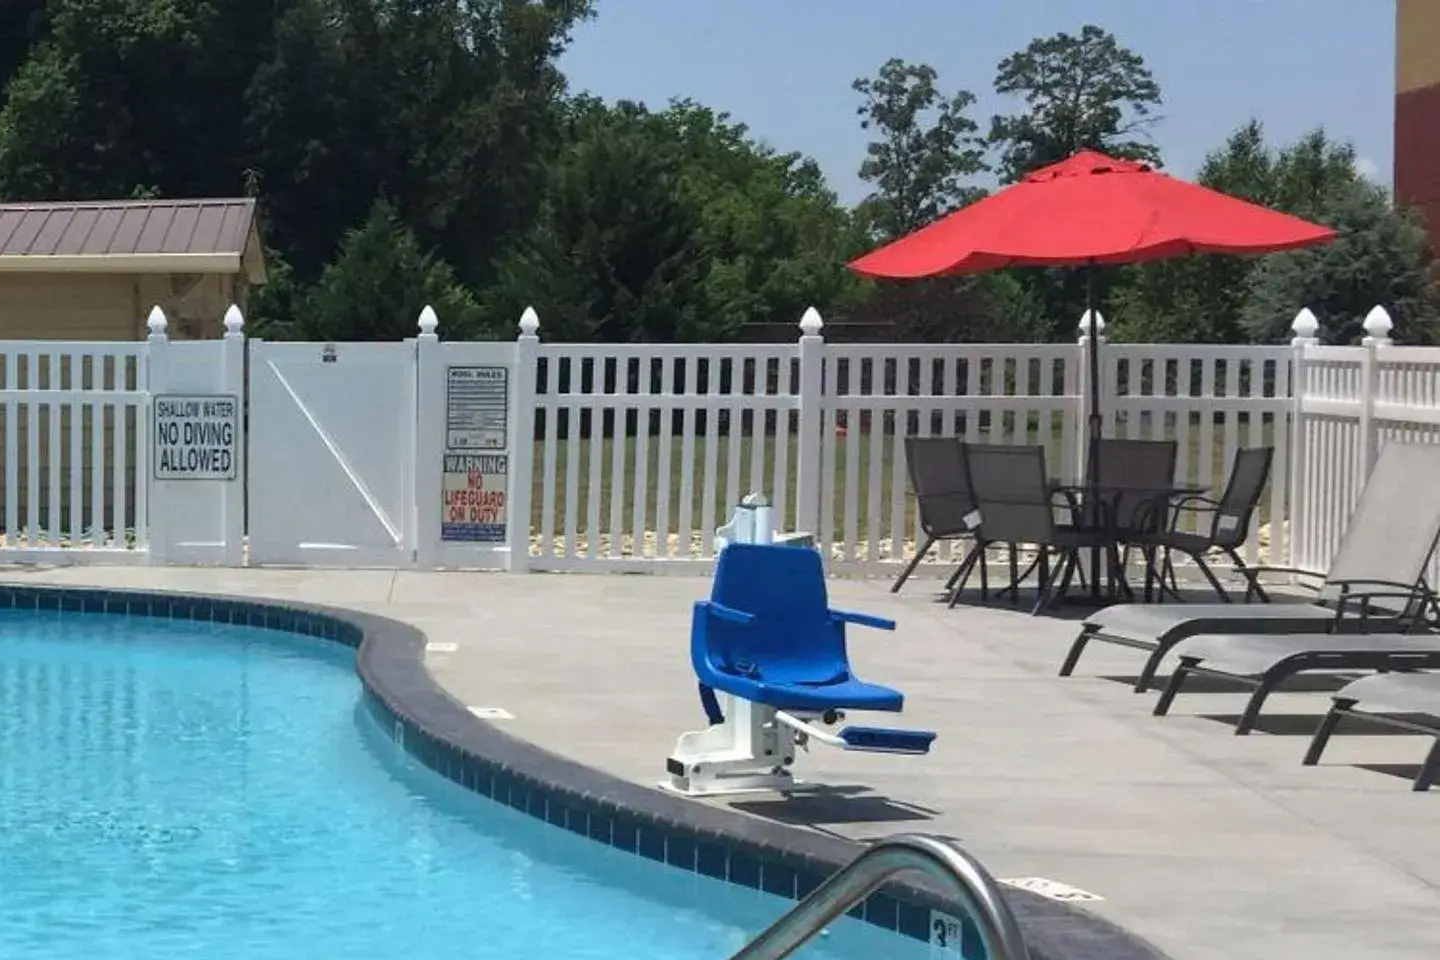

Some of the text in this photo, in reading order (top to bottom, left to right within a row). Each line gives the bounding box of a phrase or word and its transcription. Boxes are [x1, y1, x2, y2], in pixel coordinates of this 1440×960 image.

[203, 402, 233, 417] WATER
[159, 422, 232, 445] NO DIVING
[160, 448, 232, 472] ALLOWED
[445, 456, 506, 473] WARNING
[468, 469, 482, 489] NO
[445, 490, 504, 507] LIFEGUARD
[450, 506, 498, 523] ON DUTY
